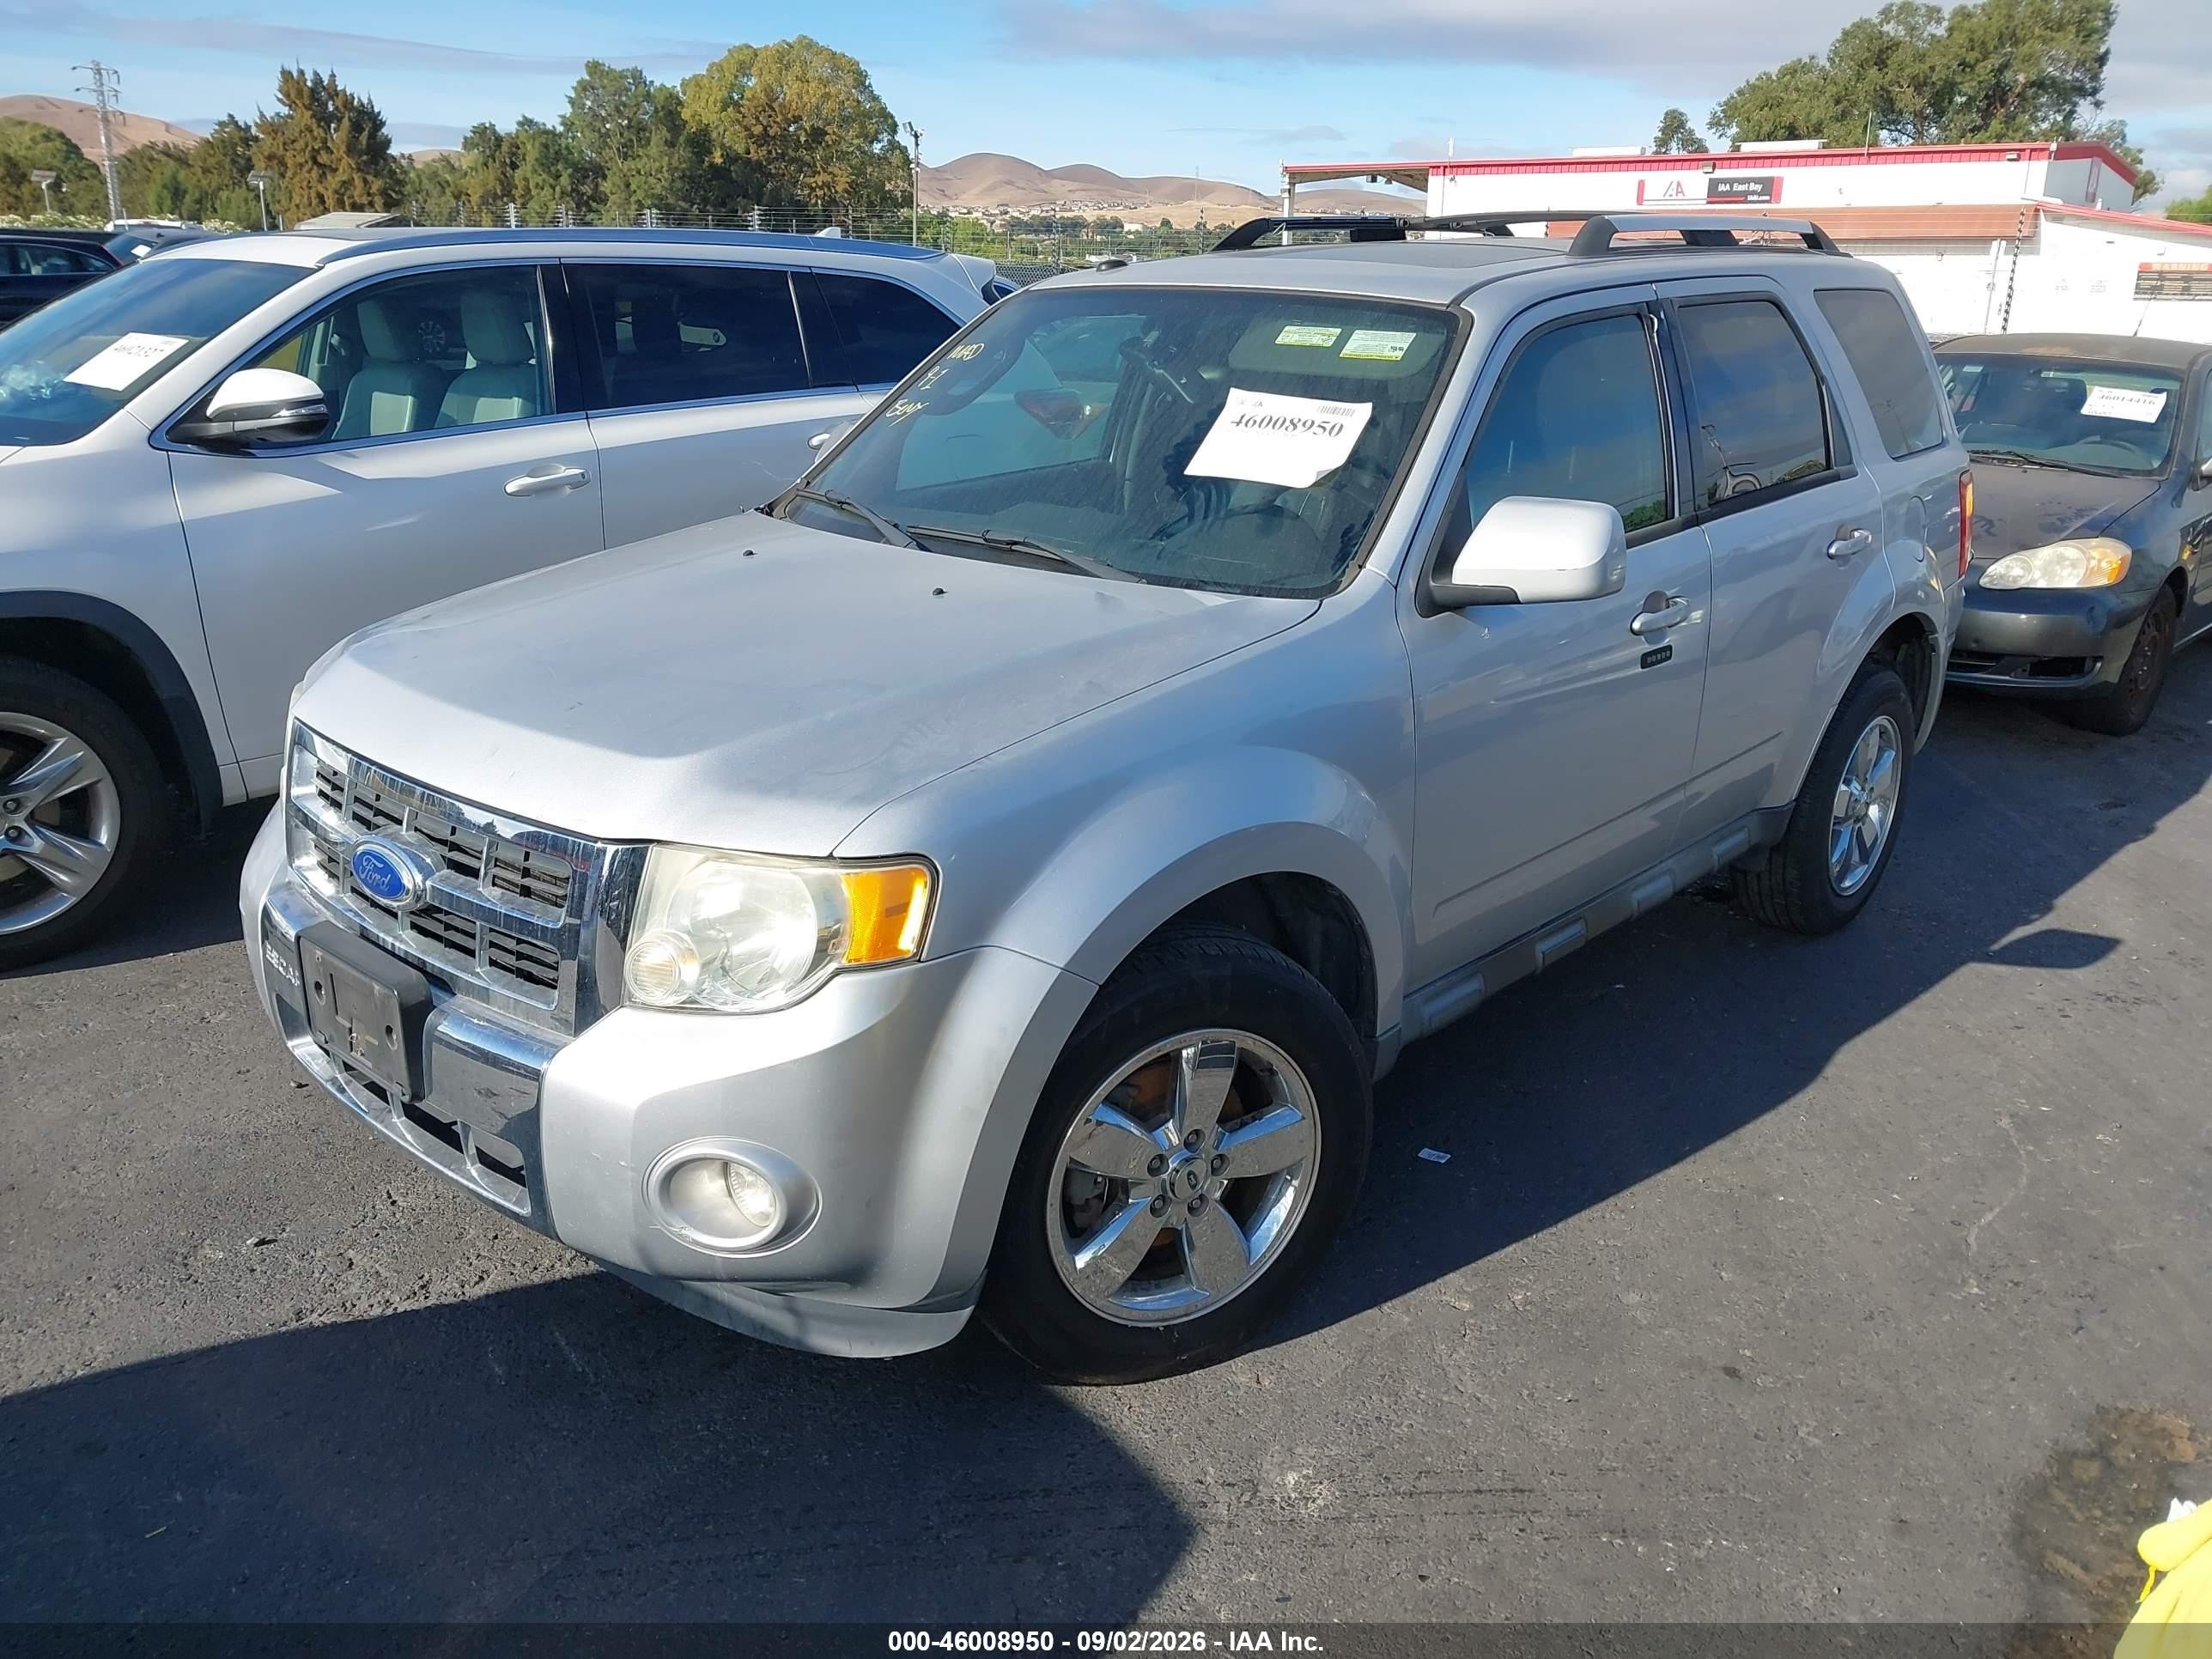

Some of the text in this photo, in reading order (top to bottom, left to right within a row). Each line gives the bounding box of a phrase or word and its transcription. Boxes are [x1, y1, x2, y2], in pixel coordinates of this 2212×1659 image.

[1717, 182, 1763, 193] IAA East Bay
[2152, 262, 2209, 271] WARNING
[1230, 412, 1345, 438] 46008950
[358, 854, 392, 891] Ford
